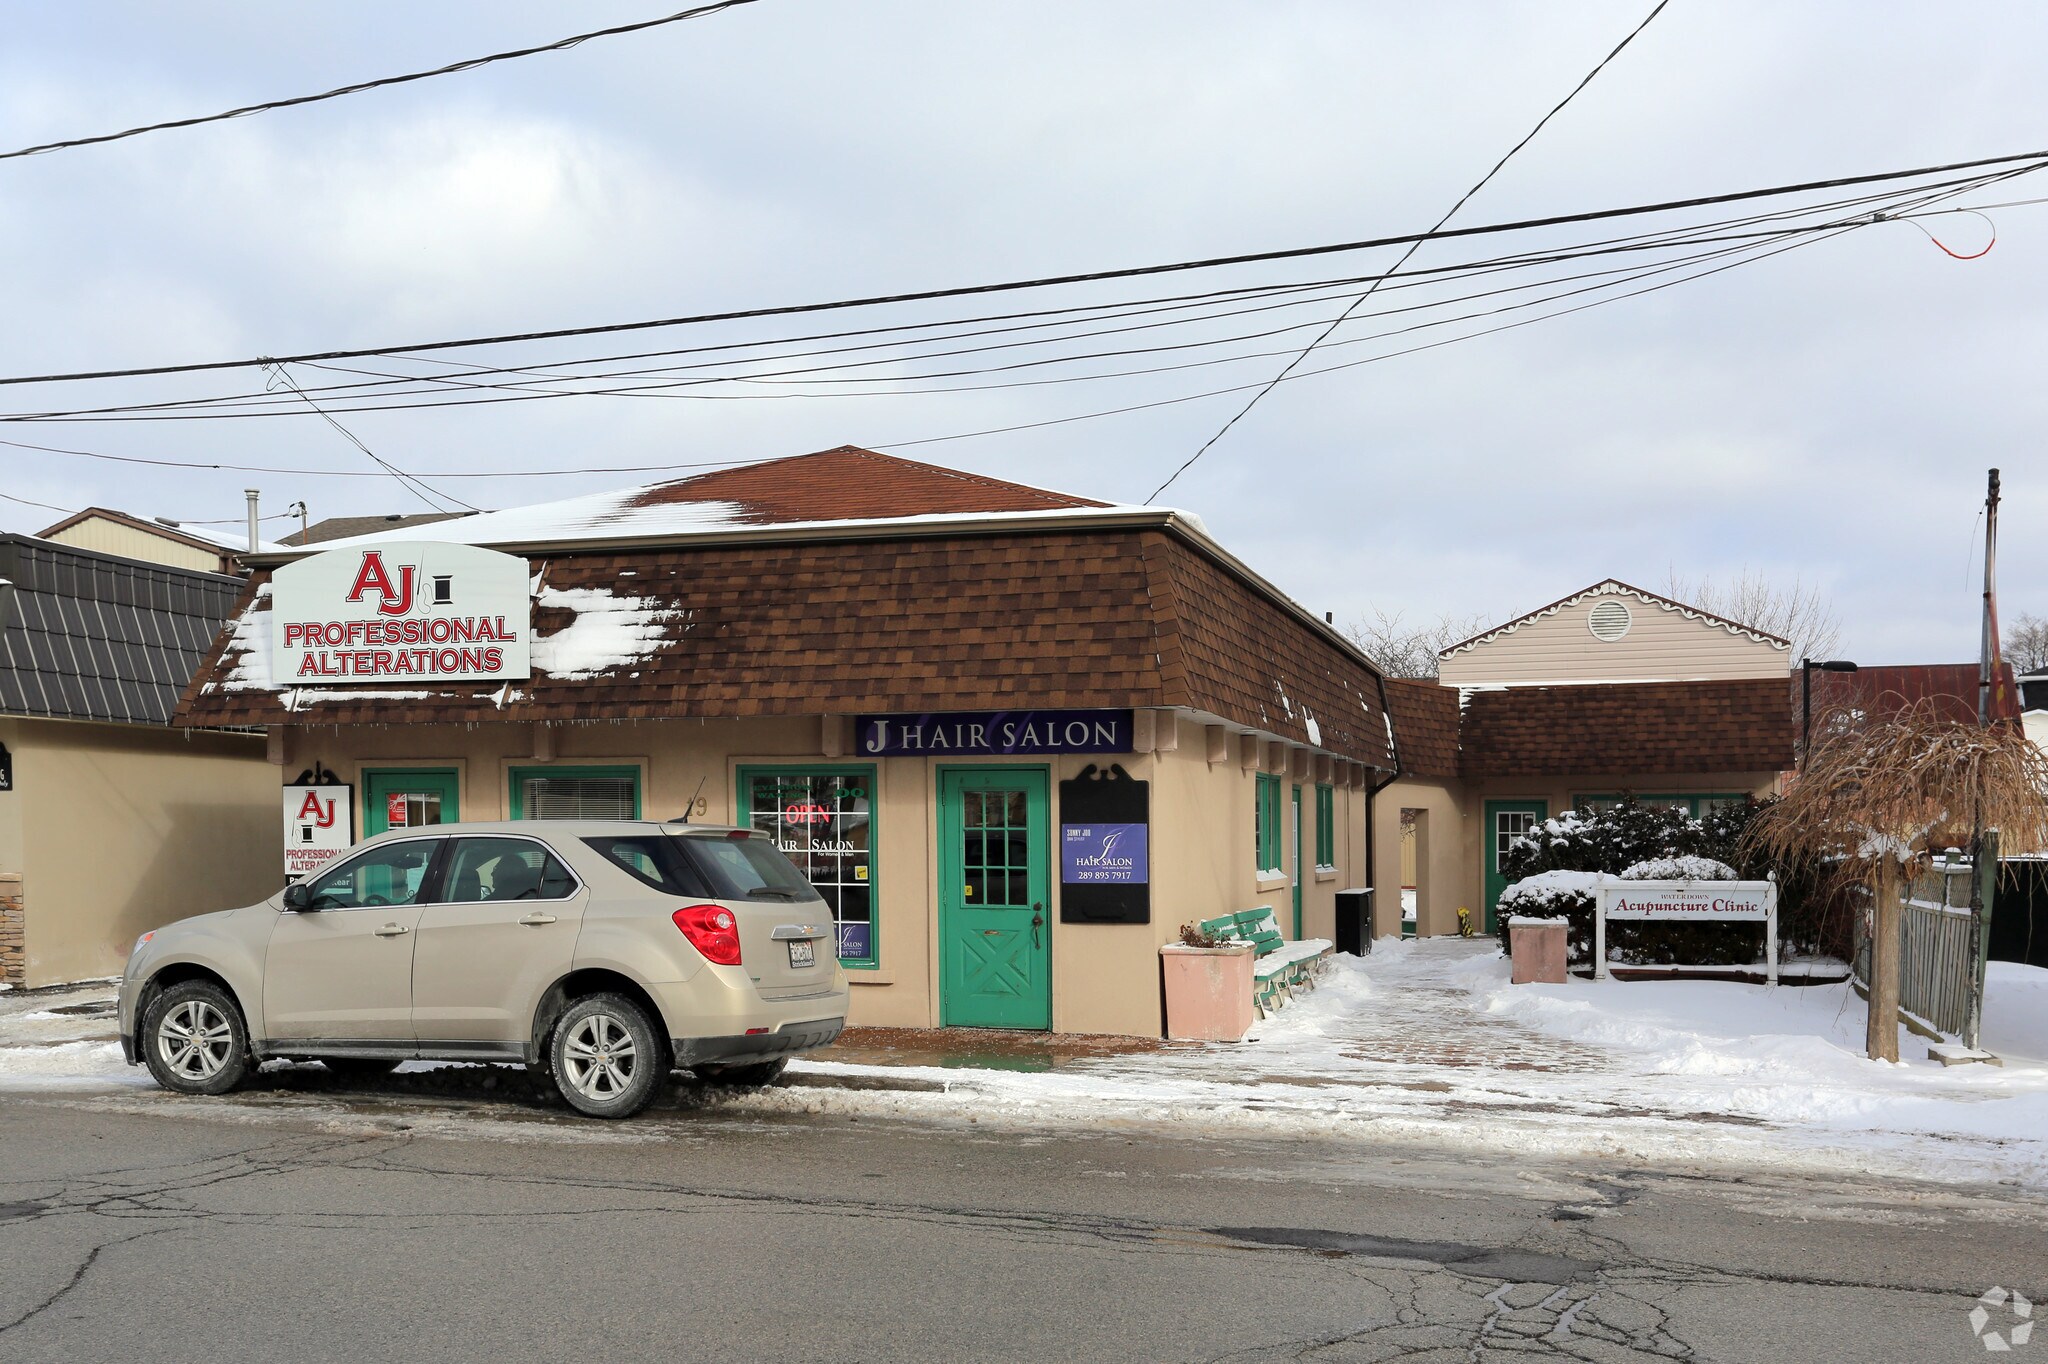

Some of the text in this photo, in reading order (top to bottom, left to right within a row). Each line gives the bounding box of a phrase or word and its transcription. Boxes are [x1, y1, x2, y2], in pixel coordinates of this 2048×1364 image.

[346, 551, 415, 617] AJ
[284, 616, 516, 648] PROFESSIONAL
[297, 647, 503, 677] ALTERATIONS
[866, 720, 1117, 752] J HAIR SALON
[297, 790, 336, 829] AJ
[785, 805, 830, 824] OPEN
[812, 838, 854, 851] SALON
[286, 849, 345, 860] PROFESSION
[1076, 857, 1132, 866] HAIR SALON
[1078, 871, 1132, 880] 289 895 7917
[1615, 898, 1758, 915] Acupuncture Clinic
